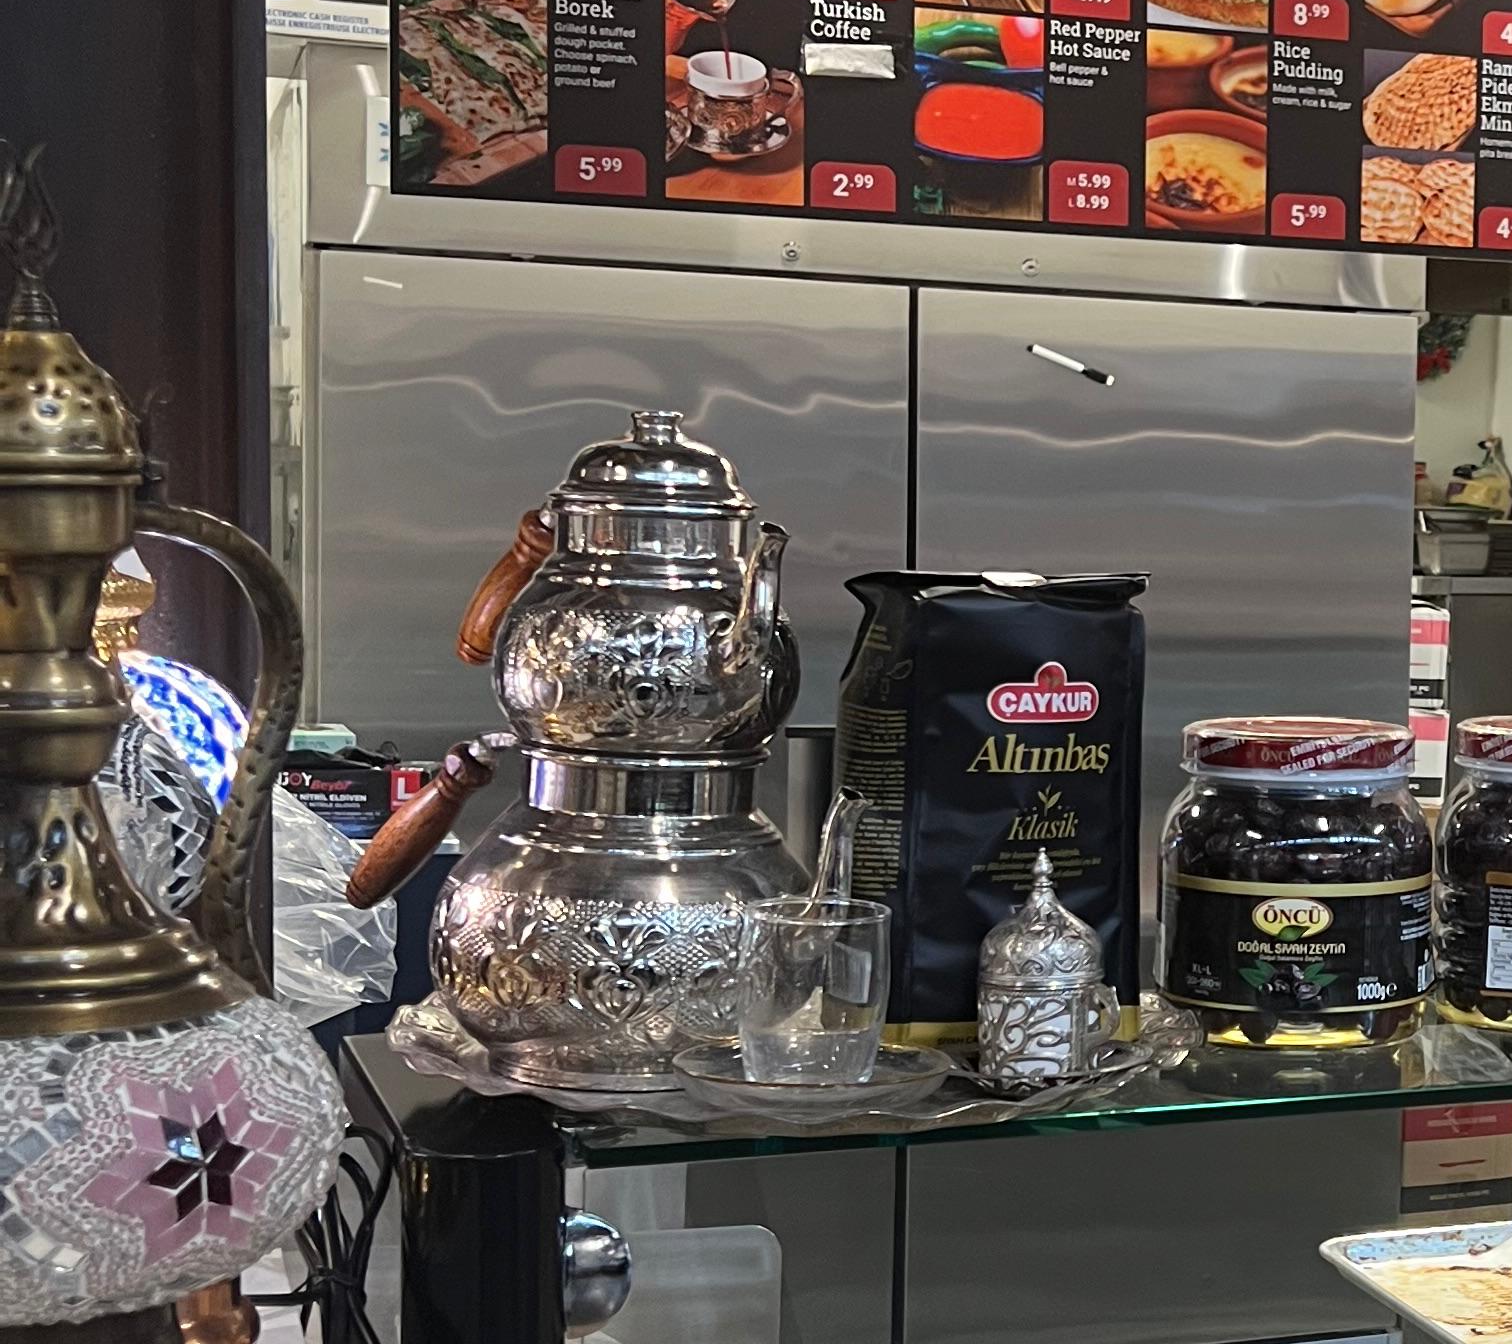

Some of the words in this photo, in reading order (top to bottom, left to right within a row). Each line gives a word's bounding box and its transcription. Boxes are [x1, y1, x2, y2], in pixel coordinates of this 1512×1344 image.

[1293, 3, 1330, 25] 8.99
[554, 22, 587, 34] Grilled
[600, 25, 636, 39] stuffed
[810, 19, 871, 41] Coffee
[1050, 20, 1081, 37] Red
[1085, 23, 1141, 44] Pepper
[1050, 40, 1079, 56] Hot
[1082, 43, 1131, 61] Sauce
[1273, 40, 1311, 60] Rice
[554, 76, 591, 88] ground
[1273, 60, 1343, 85] Pudding
[579, 157, 623, 181] 5.99
[832, 173, 874, 197] 2.99
[1078, 173, 1111, 189] 5.99
[1076, 194, 1109, 209] 8.99
[1290, 204, 1327, 227] 5.99
[999, 692, 1092, 716] ÇAYKUR
[966, 732, 1111, 774] Altınbaş
[1280, 760, 1315, 774] SEALED
[1007, 812, 1078, 840] Klasik
[1263, 905, 1321, 924] ÖNCÜ
[1237, 940, 1274, 954] DOĞAL
